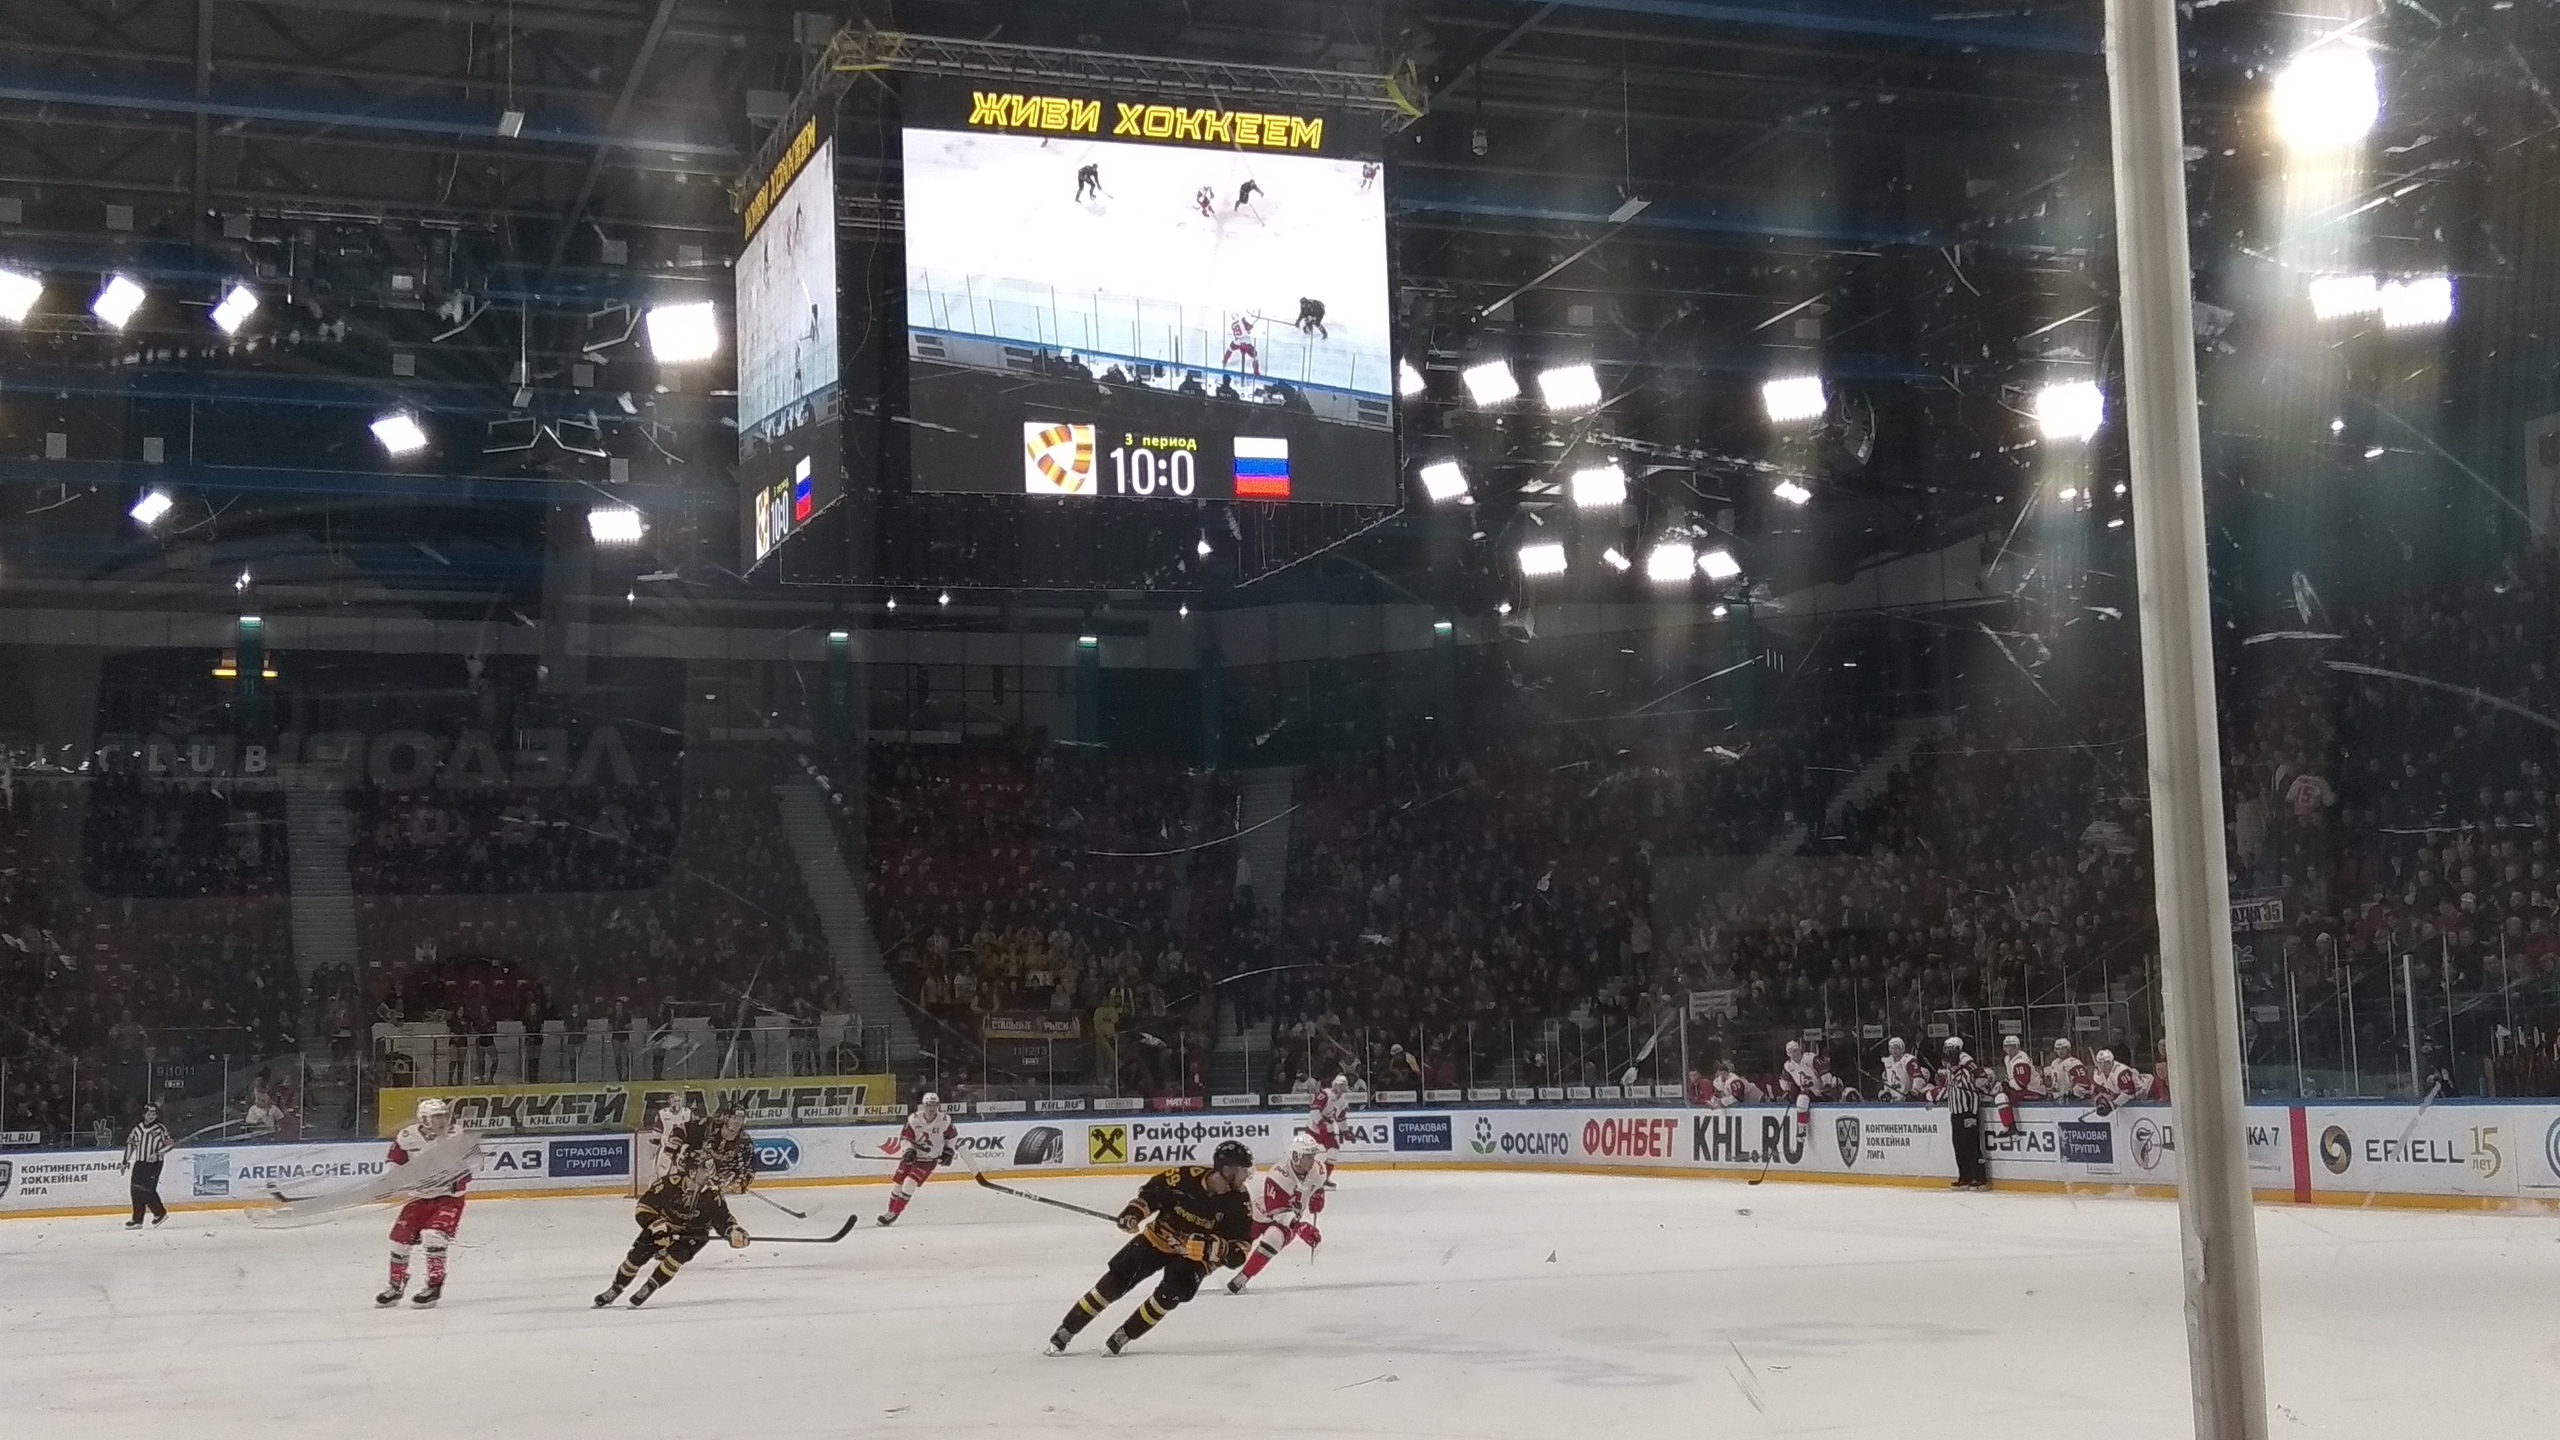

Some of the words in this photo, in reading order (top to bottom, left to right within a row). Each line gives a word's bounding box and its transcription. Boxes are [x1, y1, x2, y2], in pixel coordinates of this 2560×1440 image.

[969, 91, 1101, 133] ЖИВИ
[1113, 102, 1323, 149] ХОККЕЕМ
[1124, 433, 1133, 445] 3
[1143, 436, 1197, 450] период
[1110, 447, 1195, 496] 10:0
[771, 490, 789, 544] 10:0
[804, 1107, 842, 1116] KHL.RU
[864, 1105, 902, 1116] KHL.RU
[939, 1104, 961, 1113] L.RU
[463, 1118, 504, 1128] KHL.RU
[529, 1115, 571, 1125] KHL.RU
[1132, 1121, 1269, 1143] Райффайзен
[1398, 1122, 1448, 1133] СТРАХОВАЯ
[1865, 1123, 1938, 1134] КОНТИНЕНТАЛЬНАЯ
[0, 1133, 34, 1143] HL.RU
[1406, 1134, 1440, 1144] ГРУППА
[1582, 1117, 1678, 1157] ФОНБЕТ
[1693, 1115, 1804, 1164] KHL.RU
[1866, 1135, 1911, 1147] ХОККЕЙНАЯ
[2062, 1129, 2107, 1141] СТРАХОВАЯ
[2271, 1126, 2280, 1146] 7
[1500, 1132, 1569, 1155] ФОСАГРО
[2070, 1143, 2101, 1154] ГРУППА
[555, 1146, 623, 1158] СТРАХОВАЯ
[1134, 1144, 1197, 1163] БАНК
[1867, 1150, 1885, 1159] ЛИГА
[2365, 1139, 2465, 1164] ERIELL
[2470, 1126, 2502, 1179] 15
[21, 1162, 131, 1174] КОНТИНЕНТАЛЬНАЯ
[566, 1158, 612, 1169] ГРУППА
[2472, 1158, 2492, 1171] лет
[238, 1162, 384, 1180] ARENA-CHE.RU
[20, 1173, 88, 1185] ХОККЕЙНАЯ
[20, 1186, 47, 1196] ЛИГА
[1266, 1183, 1276, 1200] 14
